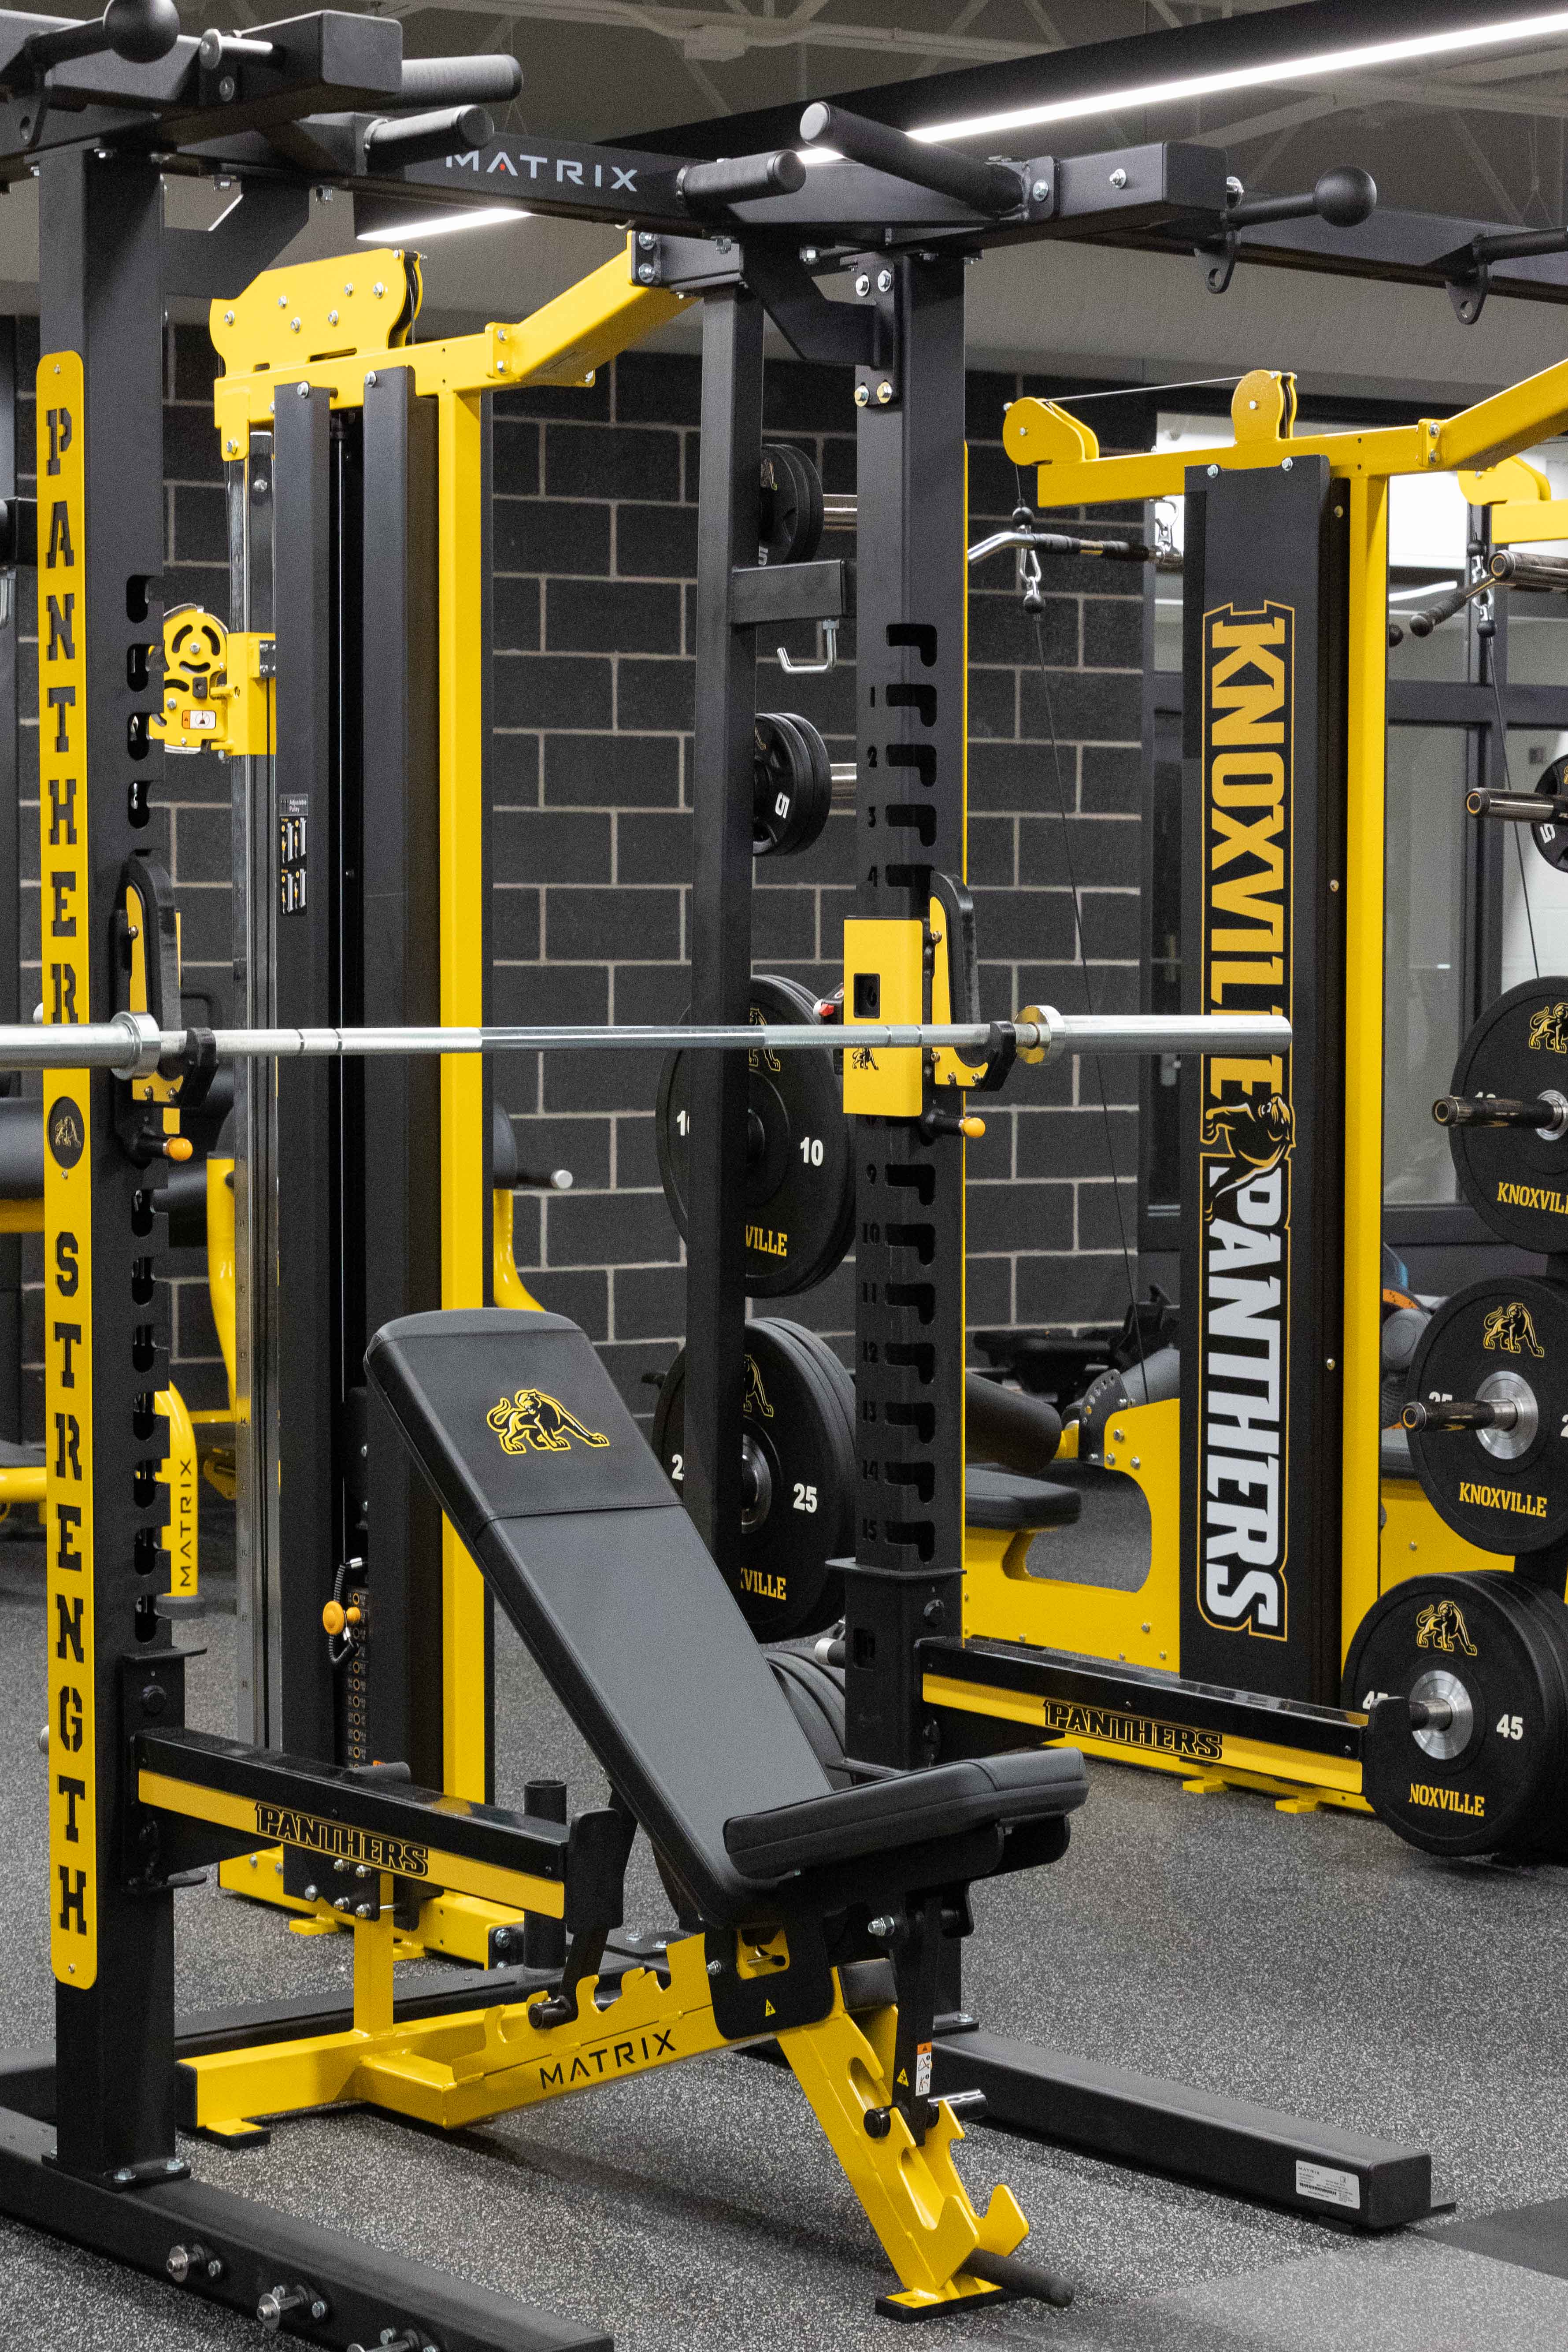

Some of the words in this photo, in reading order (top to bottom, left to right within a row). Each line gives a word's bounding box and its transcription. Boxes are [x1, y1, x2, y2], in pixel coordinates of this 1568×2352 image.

[445, 150, 638, 192] MATRIX
[870, 686, 875, 707] 1
[867, 745, 878, 768] 2
[775, 792, 790, 819] 5
[867, 806, 876, 828] 3
[1539, 823, 1556, 844] 5
[1211, 617, 1285, 1100] KNOXVILE
[867, 866, 878, 887] 4
[677, 1110, 689, 1136] 1
[800, 1137, 824, 1167] 10
[866, 1163, 877, 1185] 9
[862, 1222, 879, 1244] 10
[863, 1282, 877, 1304] 11
[862, 1341, 878, 1363] 12
[1206, 1166, 1282, 1627] PANTHERS
[863, 1400, 877, 1423] 13
[671, 1454, 685, 1481] 2
[863, 1459, 878, 1482] 14
[793, 1483, 818, 1513] 25
[1459, 1482, 1547, 1518] KNOXVILLE
[180, 1459, 192, 1587] MATRIX
[863, 1519, 877, 1542] 15
[53, 1231, 87, 1936] STRENGTH
[1043, 1699, 1223, 1760] PANTHERS
[1497, 1714, 1523, 1741] 45
[254, 1802, 430, 1876] PANTHERS
[539, 2029, 677, 2090] MATRIX
